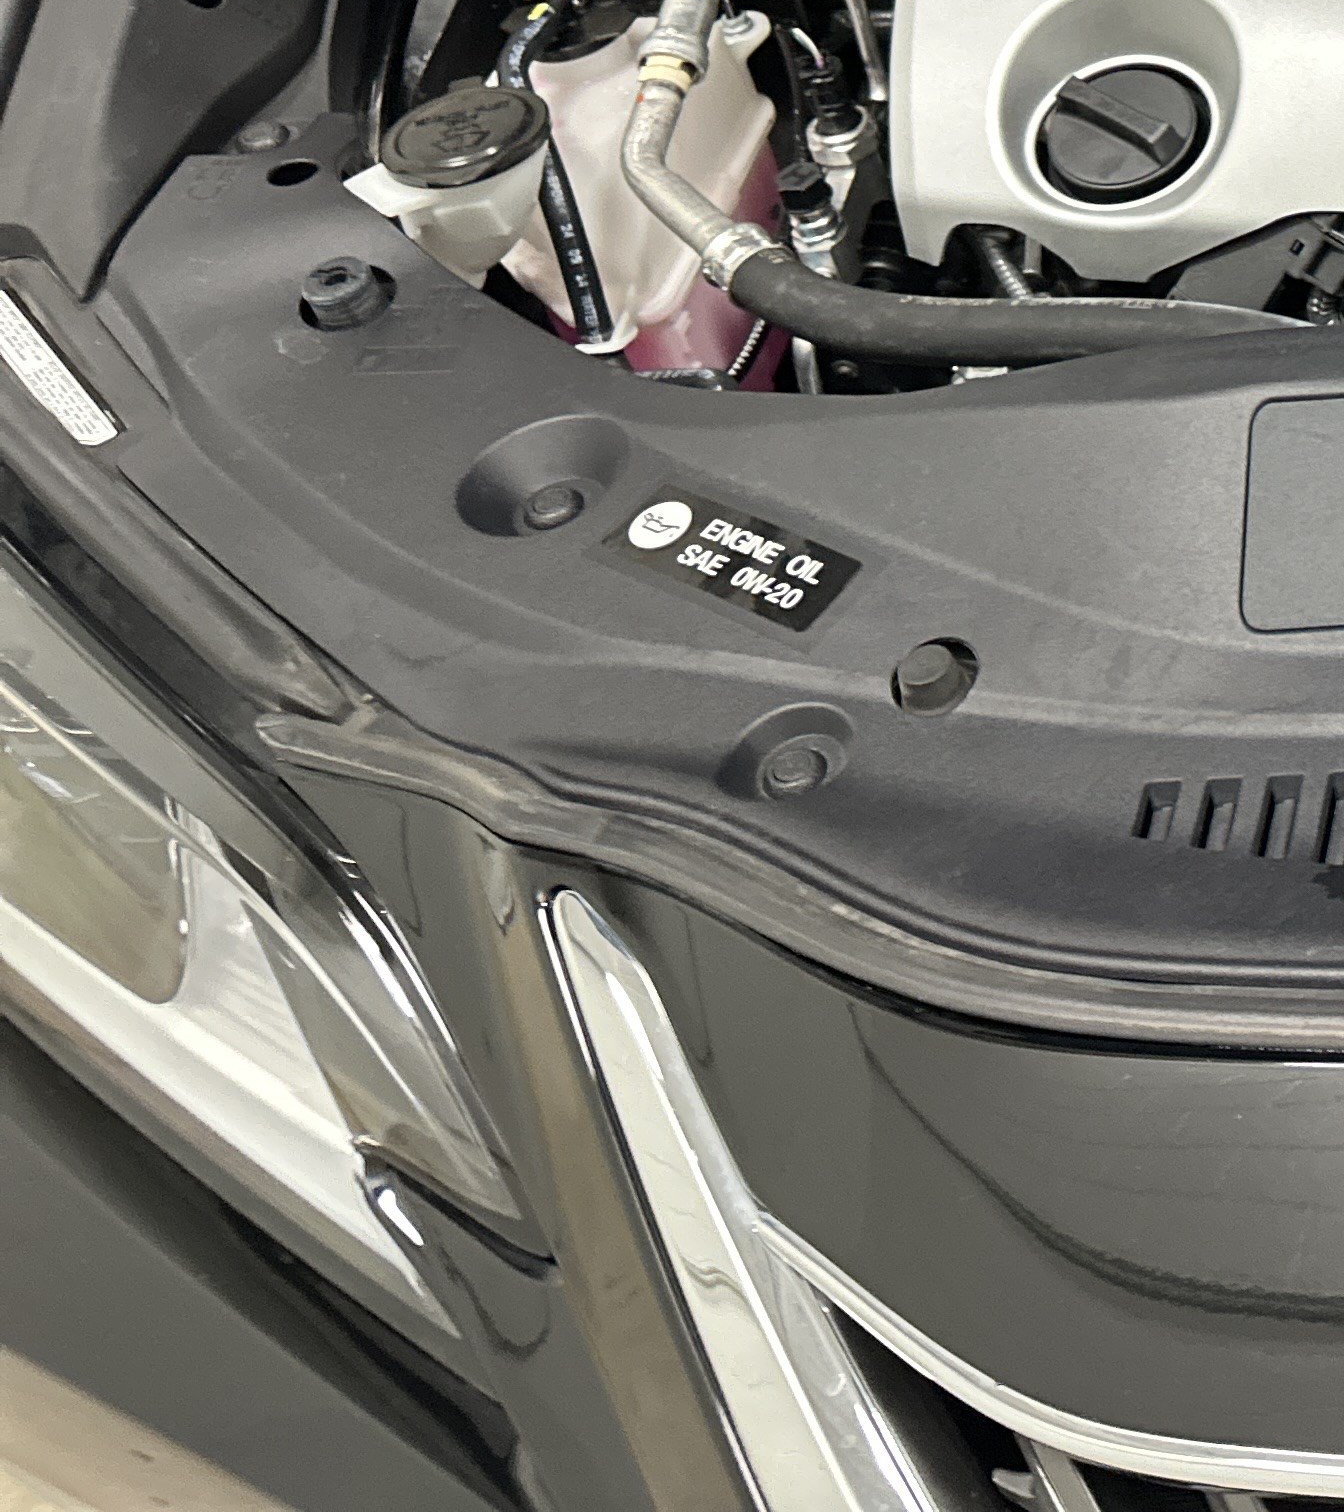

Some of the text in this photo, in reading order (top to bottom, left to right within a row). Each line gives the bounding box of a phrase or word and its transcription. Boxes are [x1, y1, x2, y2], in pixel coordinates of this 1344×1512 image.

[676, 544, 804, 609] SAE 0W-20
[700, 519, 825, 585] ENGINE OIL
